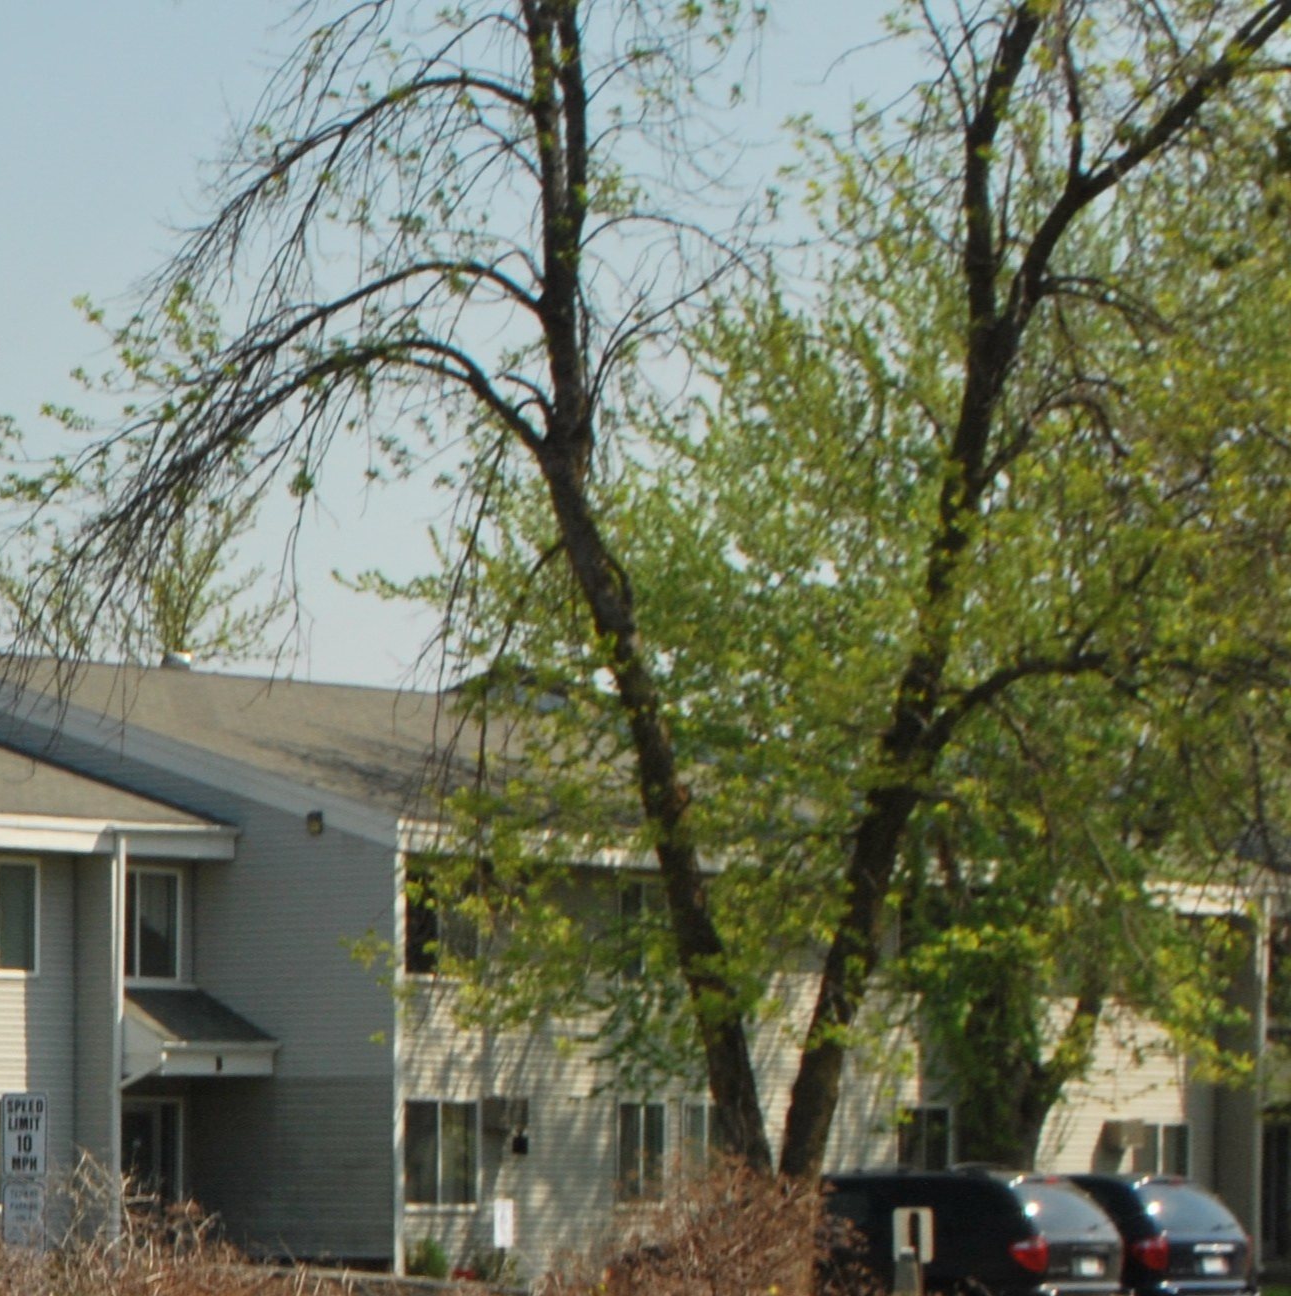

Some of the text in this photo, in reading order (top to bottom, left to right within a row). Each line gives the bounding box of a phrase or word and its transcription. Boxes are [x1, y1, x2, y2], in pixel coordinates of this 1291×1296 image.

[7, 1100, 43, 1113] SPEED
[8, 1117, 39, 1131] LIMIT
[17, 1135, 32, 1152] 10
[12, 1157, 37, 1171] MPH
